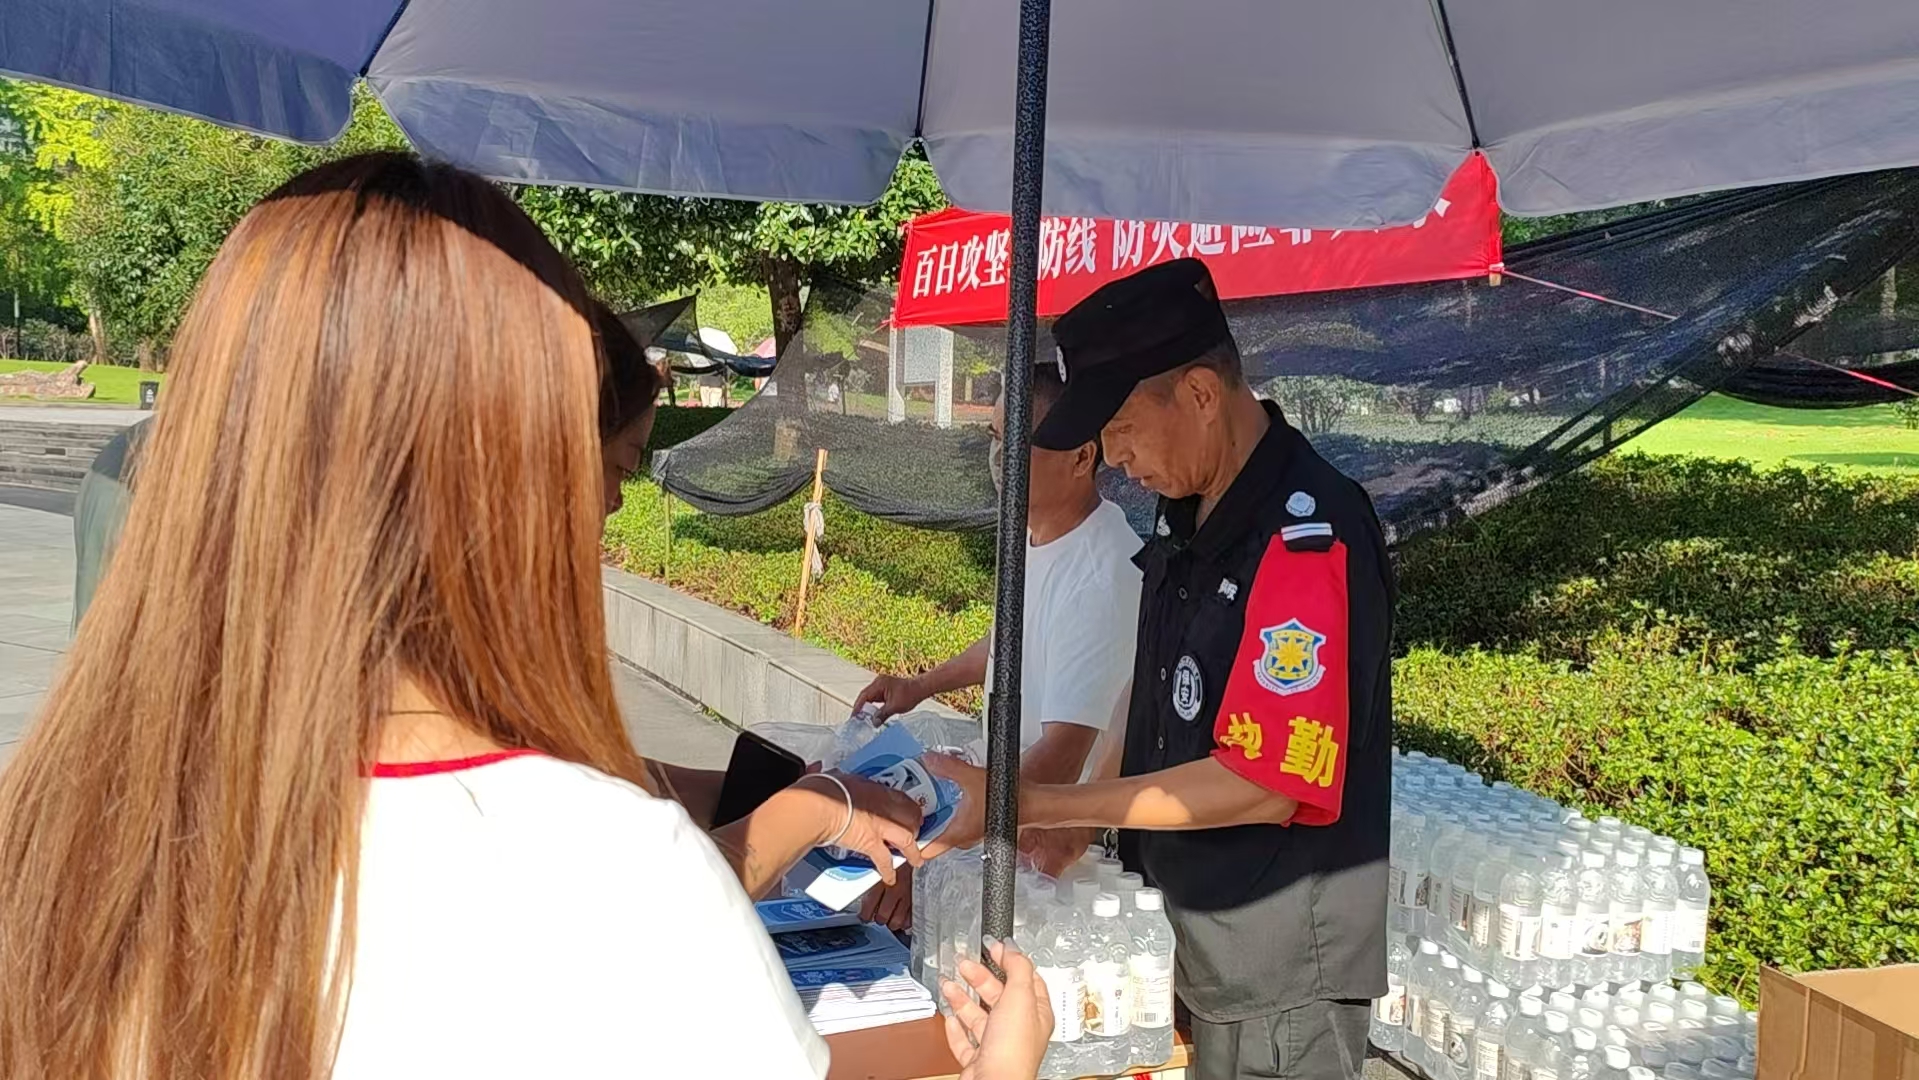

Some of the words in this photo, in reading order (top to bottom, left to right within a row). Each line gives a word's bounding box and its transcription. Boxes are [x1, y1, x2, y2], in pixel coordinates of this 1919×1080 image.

[912, 217, 1097, 299] 百日攻坚防线
